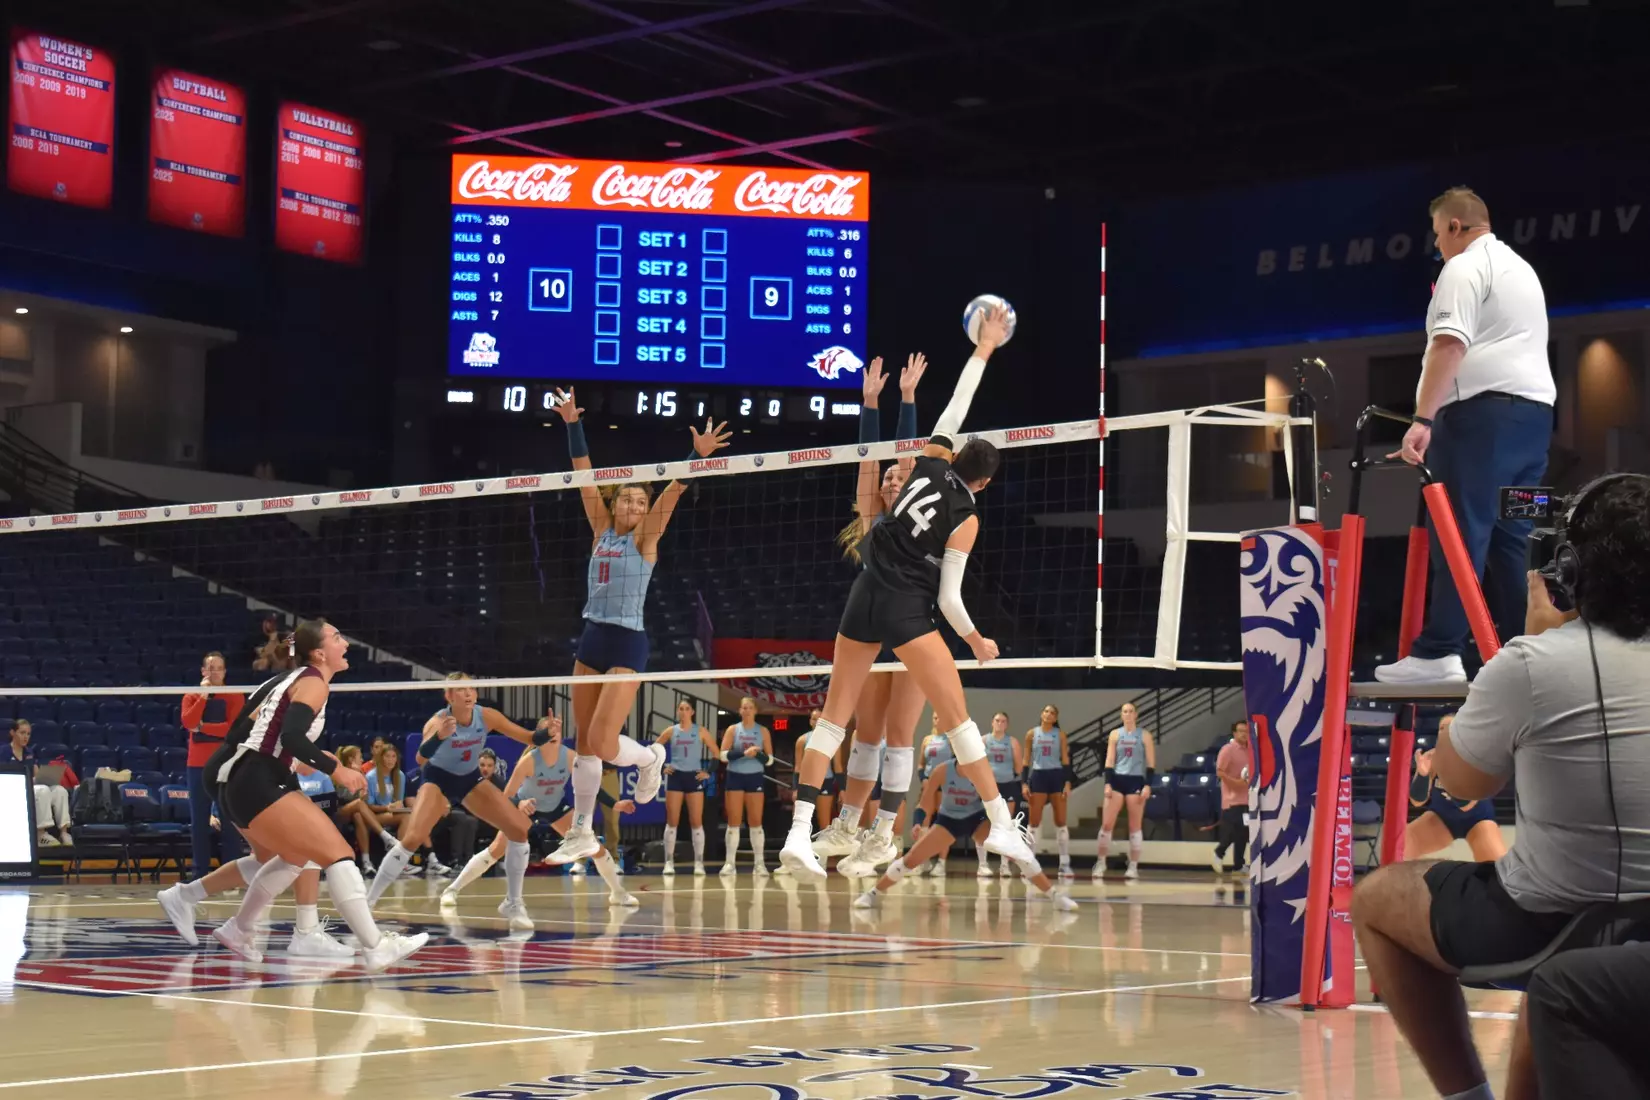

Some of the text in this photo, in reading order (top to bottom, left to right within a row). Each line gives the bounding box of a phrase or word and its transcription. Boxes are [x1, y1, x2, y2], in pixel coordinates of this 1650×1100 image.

[39, 36, 93, 61] WOMEN'S
[44, 51, 87, 72] SOCCER
[23, 62, 104, 89] CONFERENCE CHAMPIONS
[40, 78, 61, 93] 2009
[65, 85, 86, 99] 2019
[173, 78, 227, 102] SOFTBALL
[155, 109, 175, 122] 2025
[162, 98, 237, 124] CONFERENCE CHAMPIONS
[293, 110, 353, 136] VOLLEYBALL
[30, 128, 93, 150] NCAA TOURNAMENT
[289, 131, 356, 155] CONFERENCE CHAMPIONS
[38, 141, 59, 156] 2019
[324, 151, 341, 164] 2011
[170, 162, 227, 182] NCAA TOURNAMENT
[458, 160, 579, 202] Coca-Cola
[591, 164, 722, 210] Coca-Cola
[734, 170, 862, 216] Coca-Cola
[295, 192, 348, 211] NCAA TOURNAMENT
[454, 213, 510, 226] ATT% .350
[454, 233, 501, 245] KILLS 8
[638, 231, 687, 248] SET 1
[807, 228, 860, 241] ATT% .316
[453, 252, 505, 264] BLKS 0.0
[806, 248, 852, 259] KILLS 6
[1256, 231, 1436, 276] BELMO
[638, 259, 688, 277] SET 2
[806, 267, 857, 278] BLKS 0.0
[453, 272, 500, 284] ACES 1
[539, 277, 566, 299] 10
[806, 286, 851, 296] ACES 1
[452, 291, 503, 302] DIGS 12
[637, 288, 687, 305] SET 3
[765, 287, 779, 307] 9
[452, 310, 499, 321] ASTS 7
[806, 304, 852, 316] DIGS 9
[637, 317, 687, 334] SET 4
[805, 323, 852, 334] ASTS 6
[636, 345, 686, 362] SET 5
[503, 386, 527, 412] 10
[636, 391, 677, 417] 1:15
[698, 402, 704, 417] 1
[740, 399, 752, 416] 2
[768, 400, 780, 416] 0
[810, 396, 825, 420] 9
[1006, 426, 1056, 442] BRUINS
[895, 439, 929, 453] BELMO
[788, 449, 832, 464] BRUINS
[689, 458, 729, 473] BELMONT
[594, 467, 633, 481] BRUINS
[419, 484, 455, 497] BRUINS
[505, 476, 541, 489] BELMONT
[261, 497, 294, 510] BRUINS
[339, 491, 372, 503] BELMONT
[189, 504, 217, 515] BELMONT
[893, 476, 942, 538] 14
[52, 514, 78, 525] BELMONT
[117, 510, 147, 521] BRUINS
[598, 562, 610, 584] 11
[680, 1043, 980, 1072] BYRD
